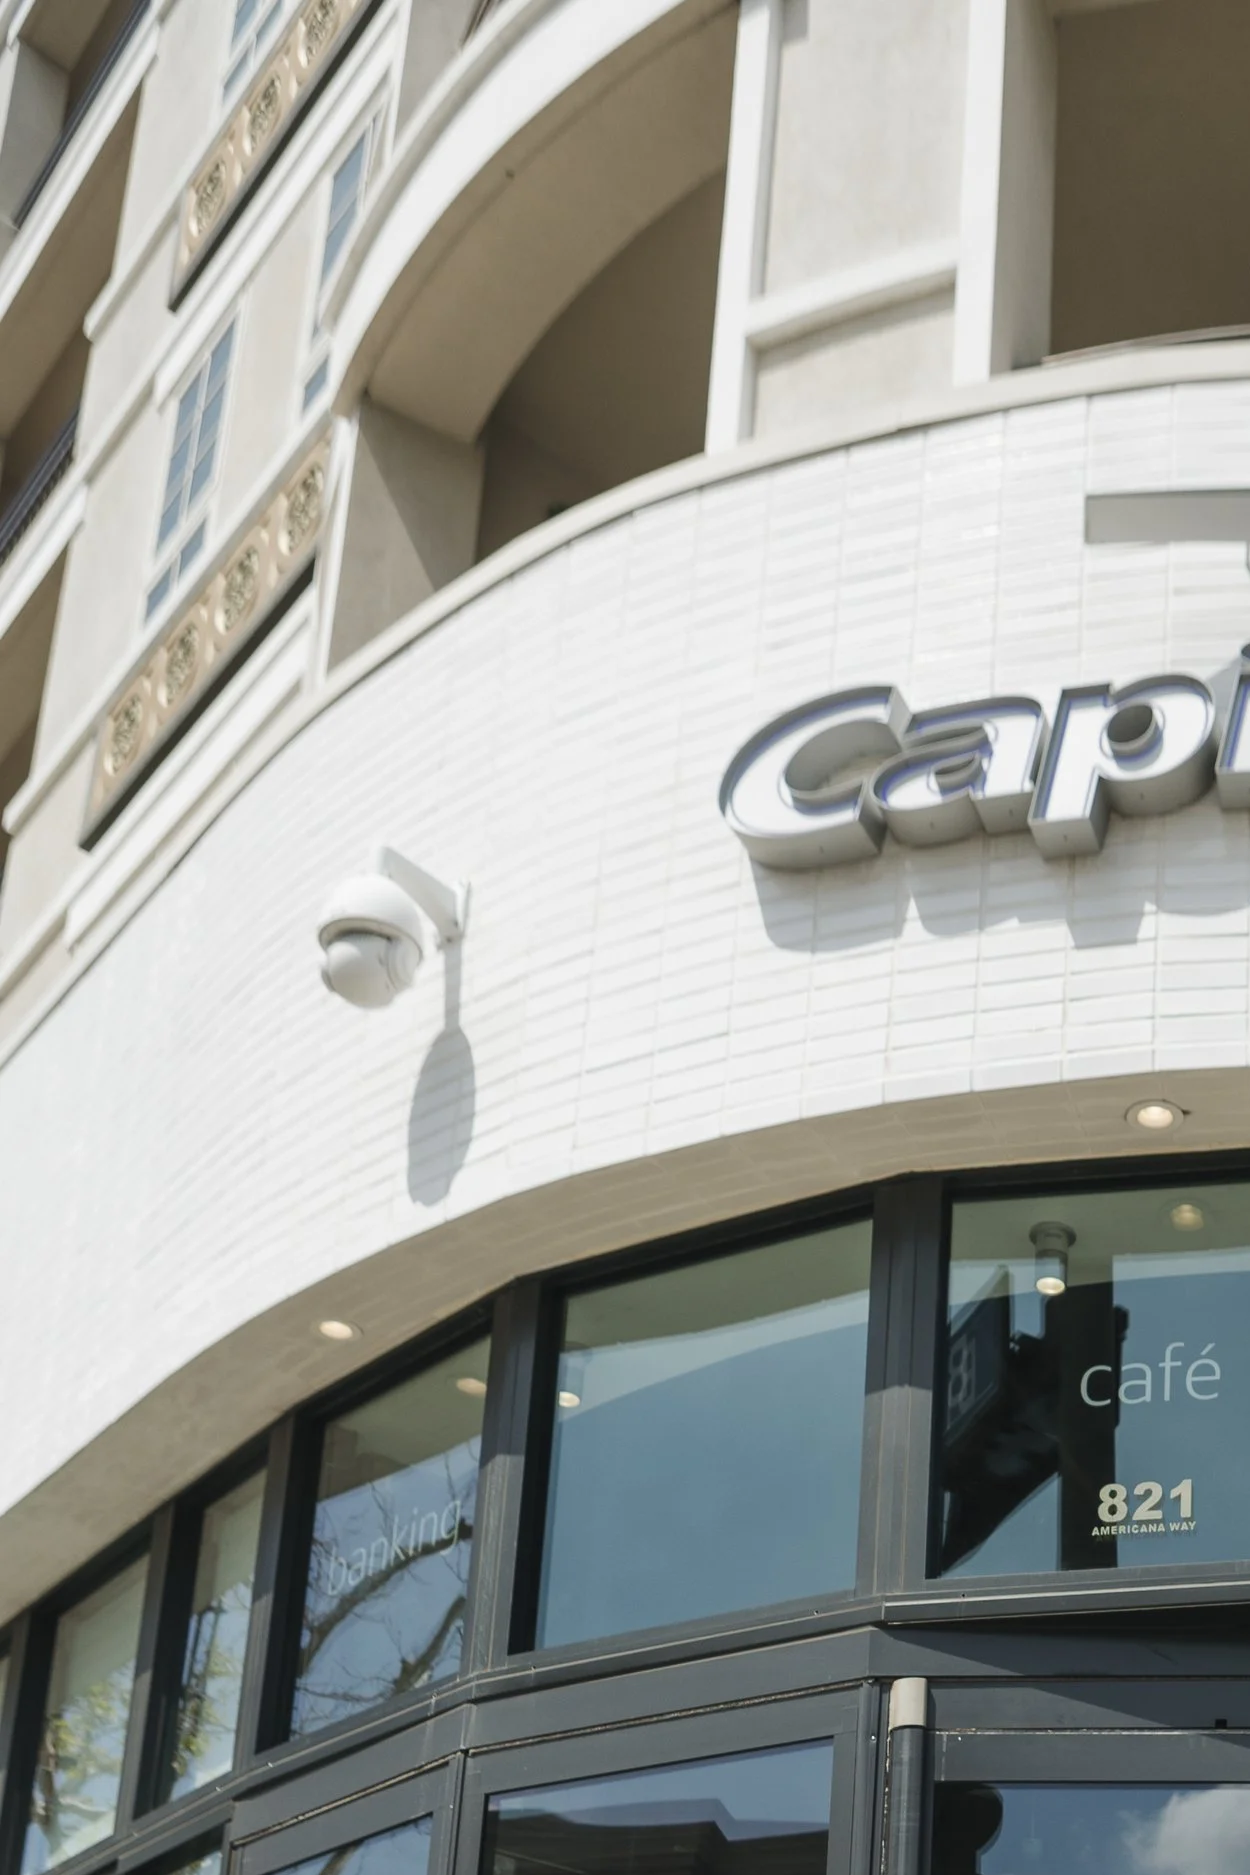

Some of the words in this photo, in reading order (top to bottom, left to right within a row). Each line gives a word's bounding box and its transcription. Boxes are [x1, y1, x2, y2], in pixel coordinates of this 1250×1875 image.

[1080, 1342, 1221, 1407] café
[1097, 1479, 1193, 1523] 821
[328, 1499, 462, 1596] banking
[1091, 1523, 1166, 1537] AMERICANA
[1169, 1520, 1196, 1532] WAY
